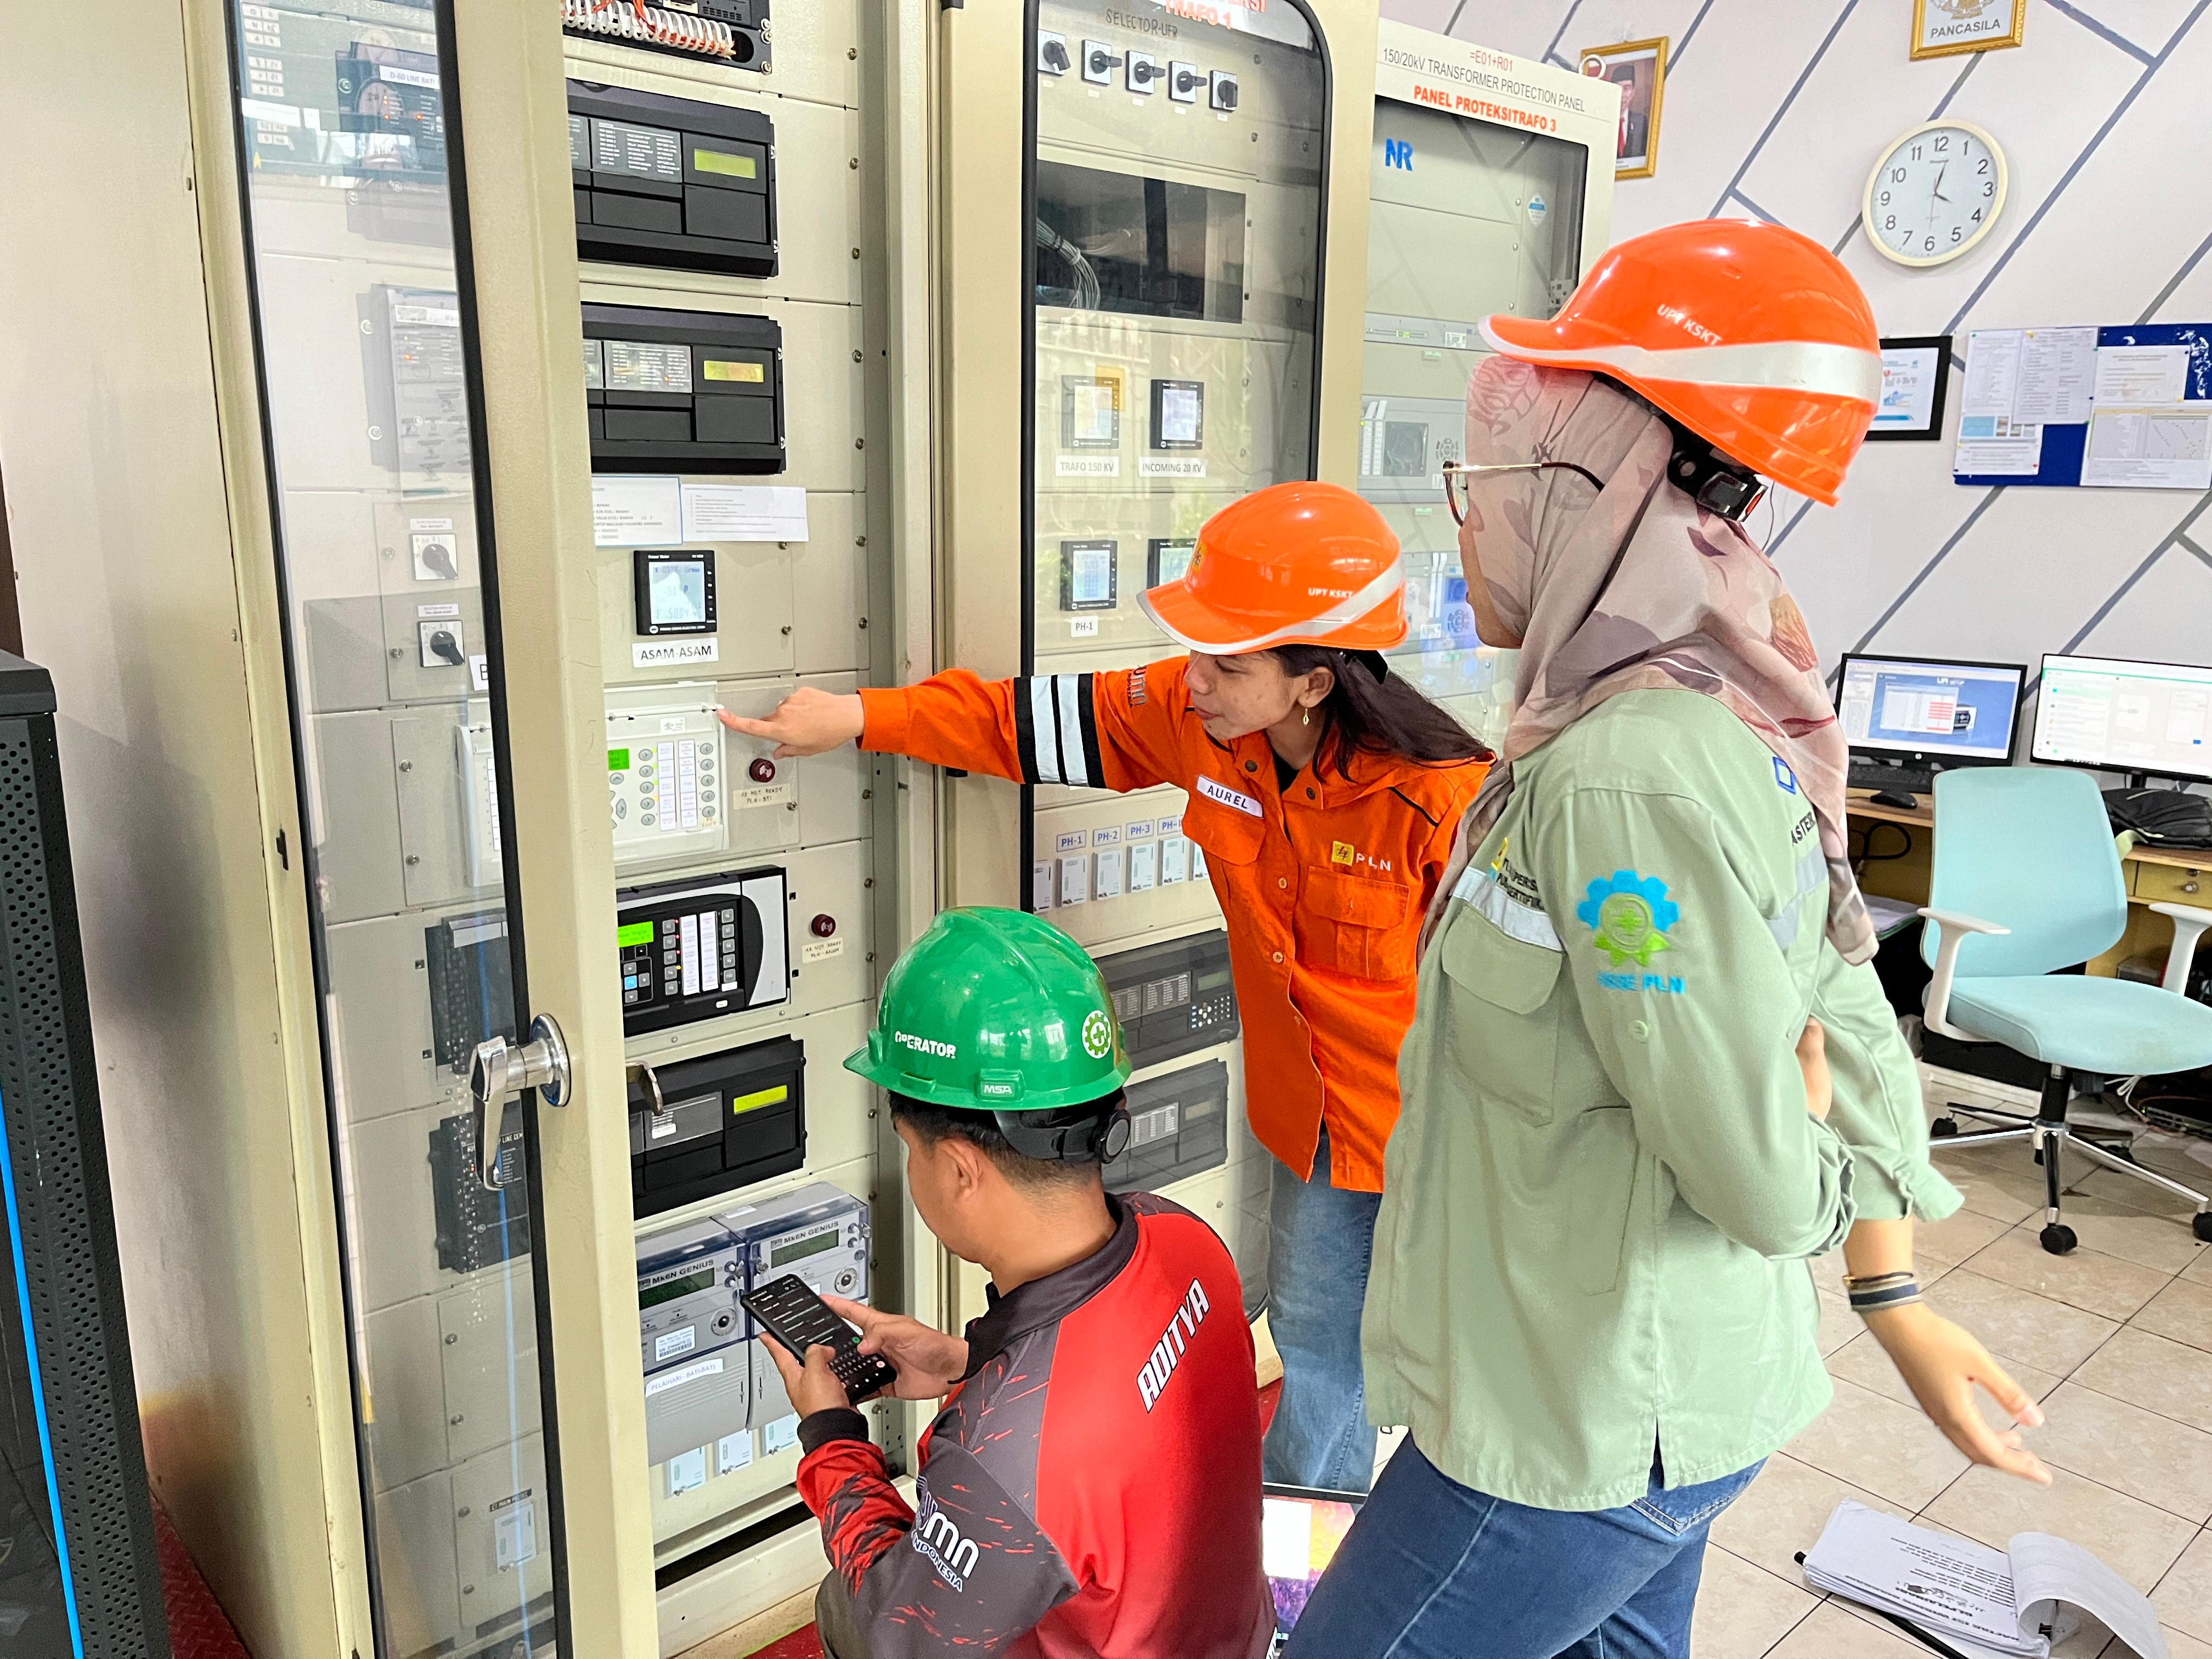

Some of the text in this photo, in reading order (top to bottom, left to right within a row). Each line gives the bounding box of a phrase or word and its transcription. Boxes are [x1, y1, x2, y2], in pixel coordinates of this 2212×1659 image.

[1105, 8, 1178, 38] SELECTOR-UFR
[1165, 0, 1233, 30] TRAFO 1
[1931, 19, 2001, 39] PANCASILA
[1469, 49, 1514, 72] =E01+R01
[407, 75, 420, 83] LINE
[1383, 47, 1585, 112] 150/20kV TRANSFORMER PROTECTION PANEL
[1413, 84, 1452, 108] PANEL
[1549, 119, 1557, 132] 3
[1934, 137, 1949, 152] 12
[1963, 140, 1969, 156] 1
[1385, 138, 1414, 172] NR
[1911, 145, 1922, 161] 11
[1977, 159, 1989, 174] 2
[1891, 167, 1906, 183] 10
[1983, 182, 1994, 197] 3
[1880, 191, 1891, 206] 9
[1885, 215, 1897, 230] 8
[1971, 207, 1982, 223] 4
[1902, 230, 1914, 246] 7
[1951, 227, 1962, 242] 5
[1925, 236, 1936, 251] 6
[1683, 318, 1723, 346] KSKT
[1060, 462, 1115, 472] TRAFO 150 KV
[1142, 462, 1203, 473] INCOMING 20 KV
[1308, 588, 1354, 599] UPT KSKT
[1075, 622, 1093, 631] PH-1
[640, 645, 712, 661] ASAM-ASAM
[1206, 785, 1248, 810] AUREL
[1097, 831, 1118, 842] PH-2
[1130, 824, 1150, 836] PH-3
[1061, 836, 1083, 847] PH-1
[1355, 852, 1391, 872] PLN
[895, 1030, 956, 1060] OPERATOR
[983, 1084, 1013, 1095] MSA
[784, 1221, 839, 1244] Mk6N GENIUS
[652, 1271, 677, 1284] Mk6N
[679, 1259, 714, 1276] GENIUS
[1137, 1277, 1210, 1414] ADITYA
[651, 1375, 681, 1391] PELAIHARI
[686, 1364, 716, 1378] BATI-BATI
